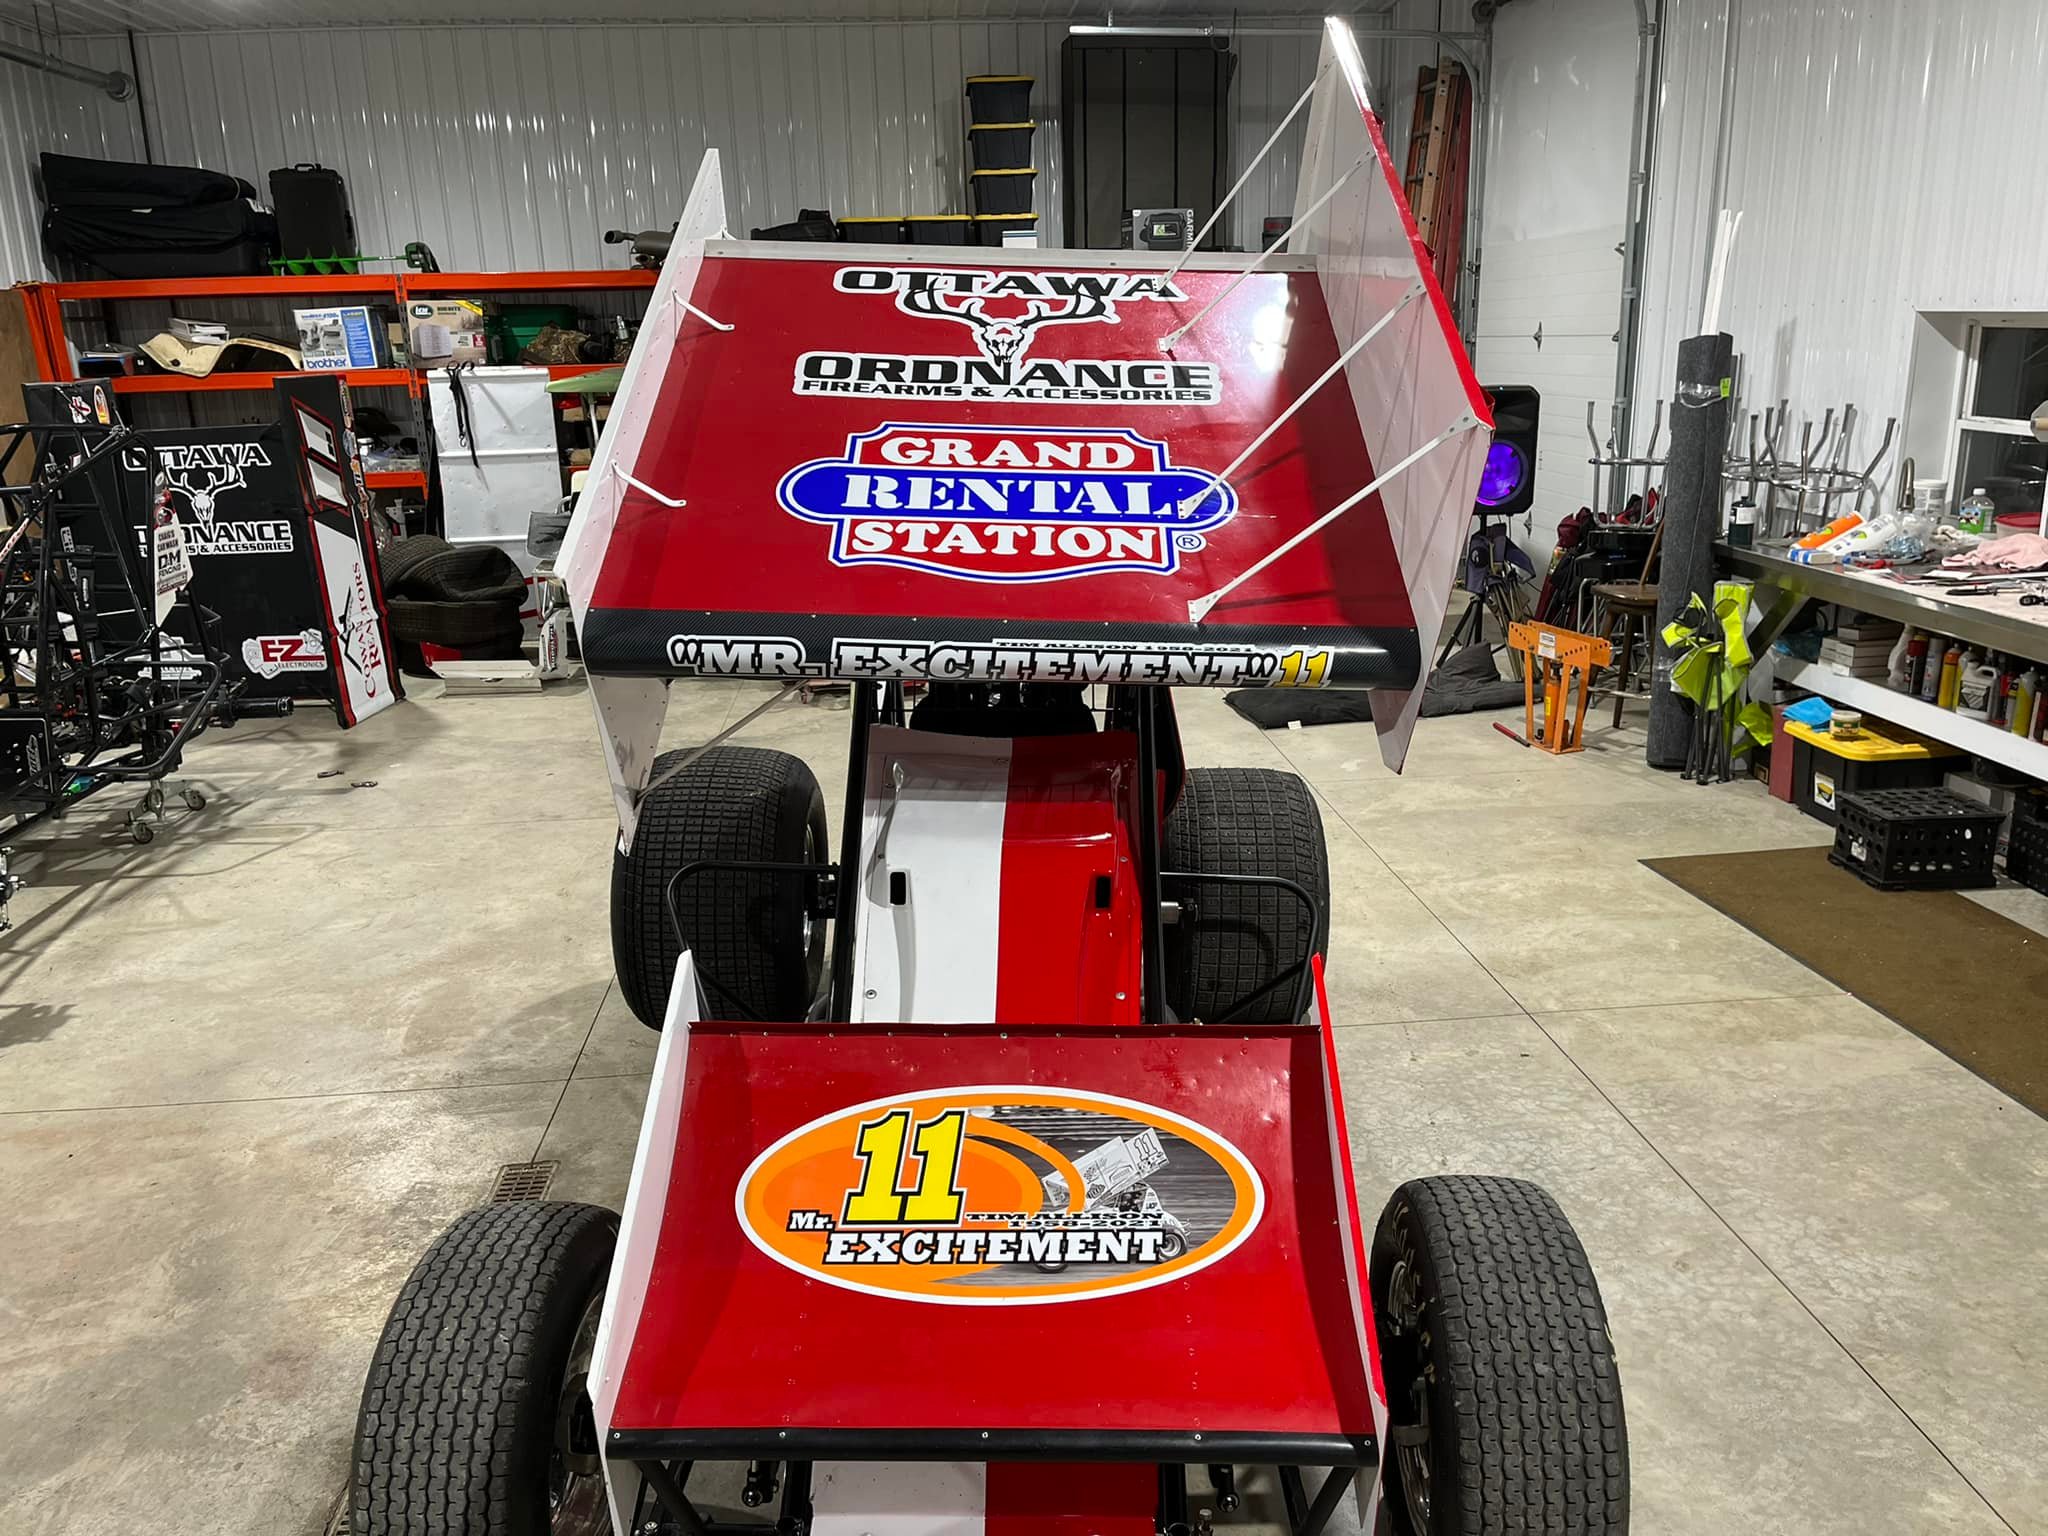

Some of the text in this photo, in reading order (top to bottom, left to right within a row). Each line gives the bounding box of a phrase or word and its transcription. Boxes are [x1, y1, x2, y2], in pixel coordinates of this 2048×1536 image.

[840, 270, 1187, 298] OTTAWA
[306, 358, 347, 370] brother
[803, 355, 1212, 389] ORDNANCE
[802, 380, 1212, 401] FIREARMS & ACCESSORIES
[880, 438, 1136, 469] GRAND
[841, 473, 1173, 516] RENTAL
[213, 541, 292, 553] ACCESSORIES
[851, 522, 1157, 560] STATION
[260, 640, 325, 662] EZ
[278, 661, 325, 669] ELECTRONICS
[1274, 649, 1332, 688] 11
[842, 1109, 965, 1226] 11
[788, 1211, 834, 1230] Mr.
[966, 1212, 1164, 1221] TIM ALLISON
[1008, 1219, 1161, 1228] 1958-2021
[825, 1231, 1166, 1263] EXCITEMENT
